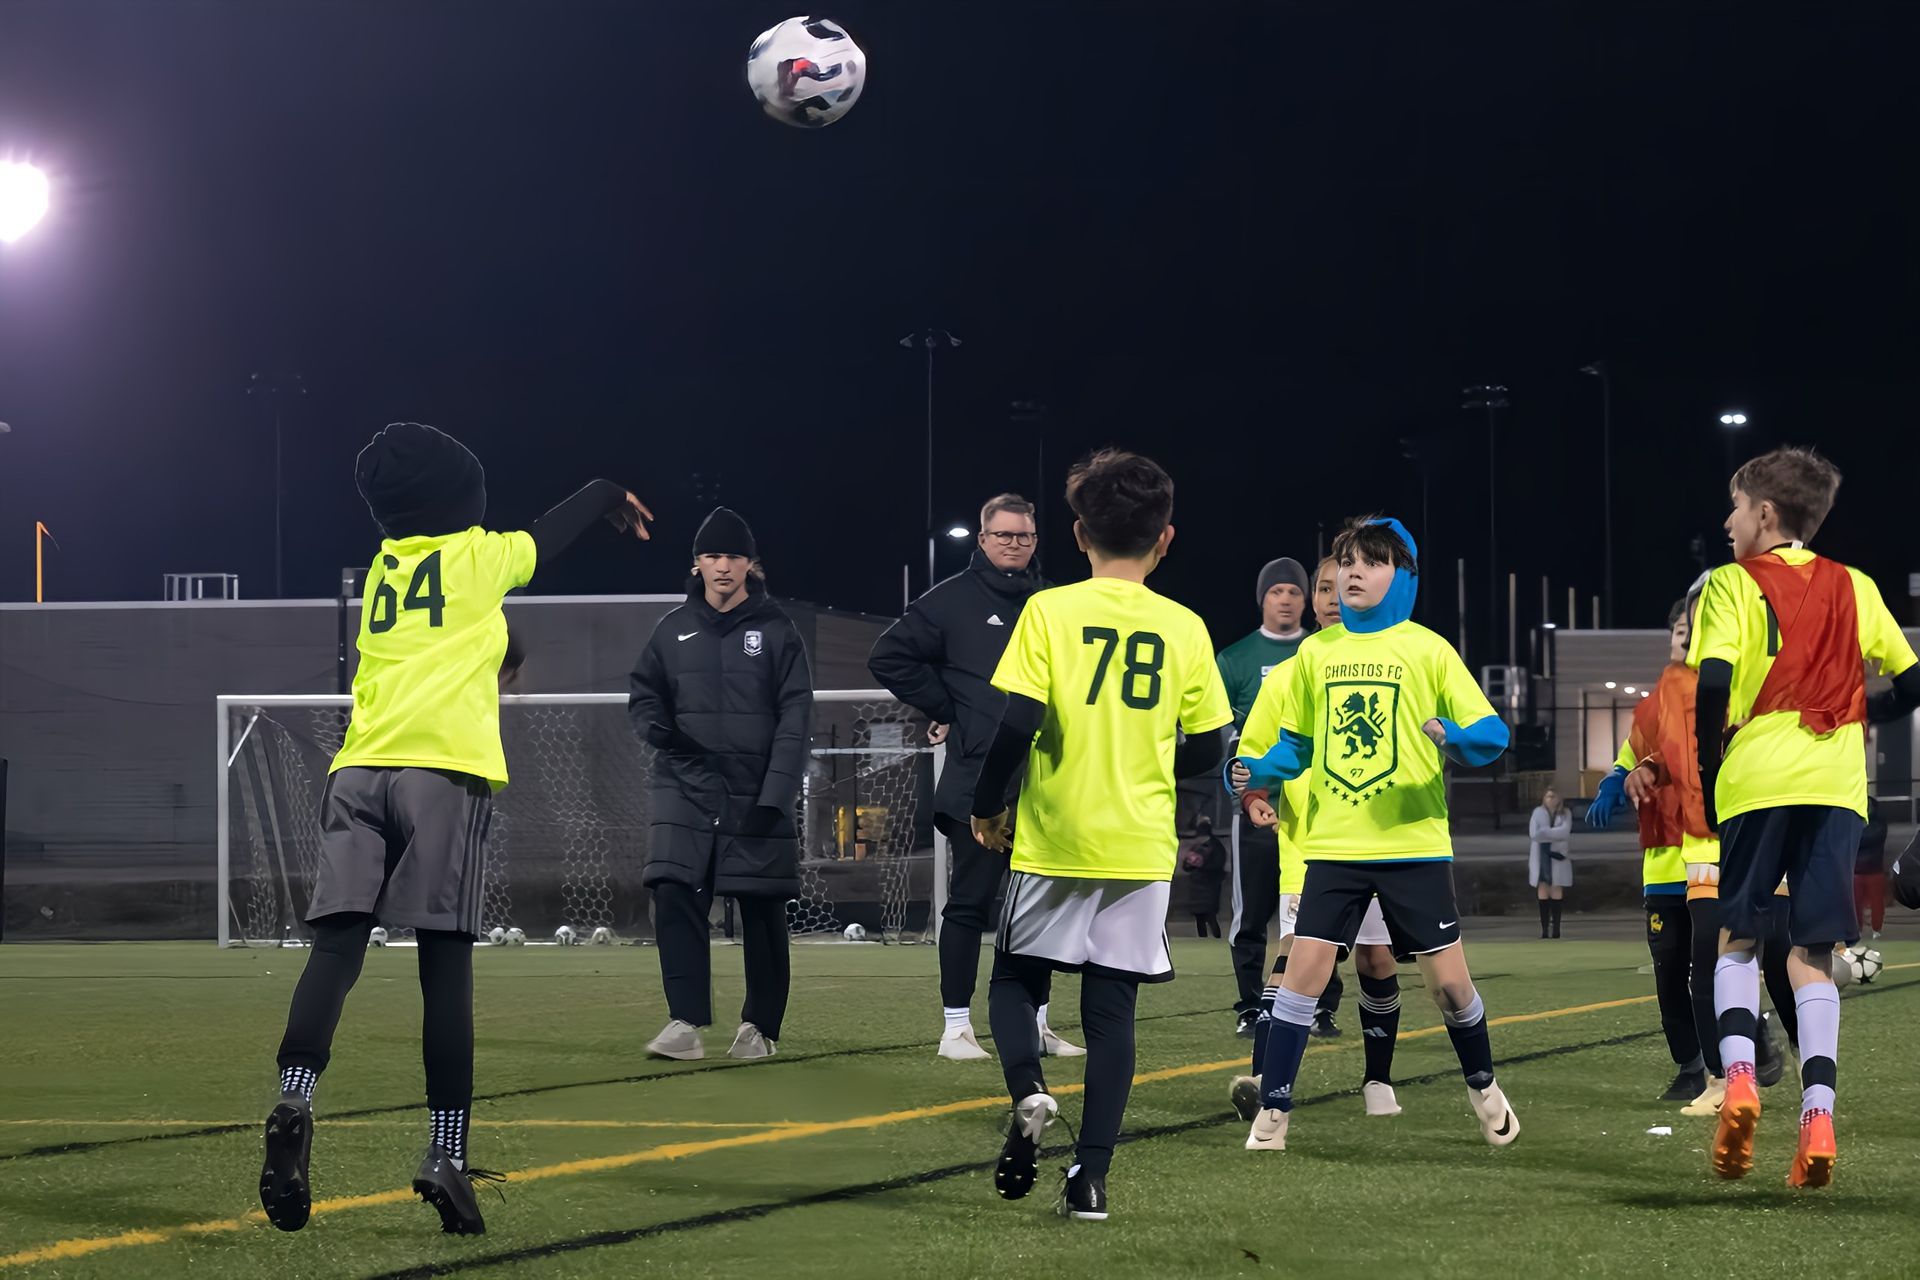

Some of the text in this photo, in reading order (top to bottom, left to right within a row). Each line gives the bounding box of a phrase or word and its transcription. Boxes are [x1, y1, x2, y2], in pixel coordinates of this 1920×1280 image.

[368, 549, 446, 634] 64
[1082, 626, 1165, 710] 78
[1325, 663, 1403, 680] CHRISTOS FC
[1350, 768, 1364, 778] 97
